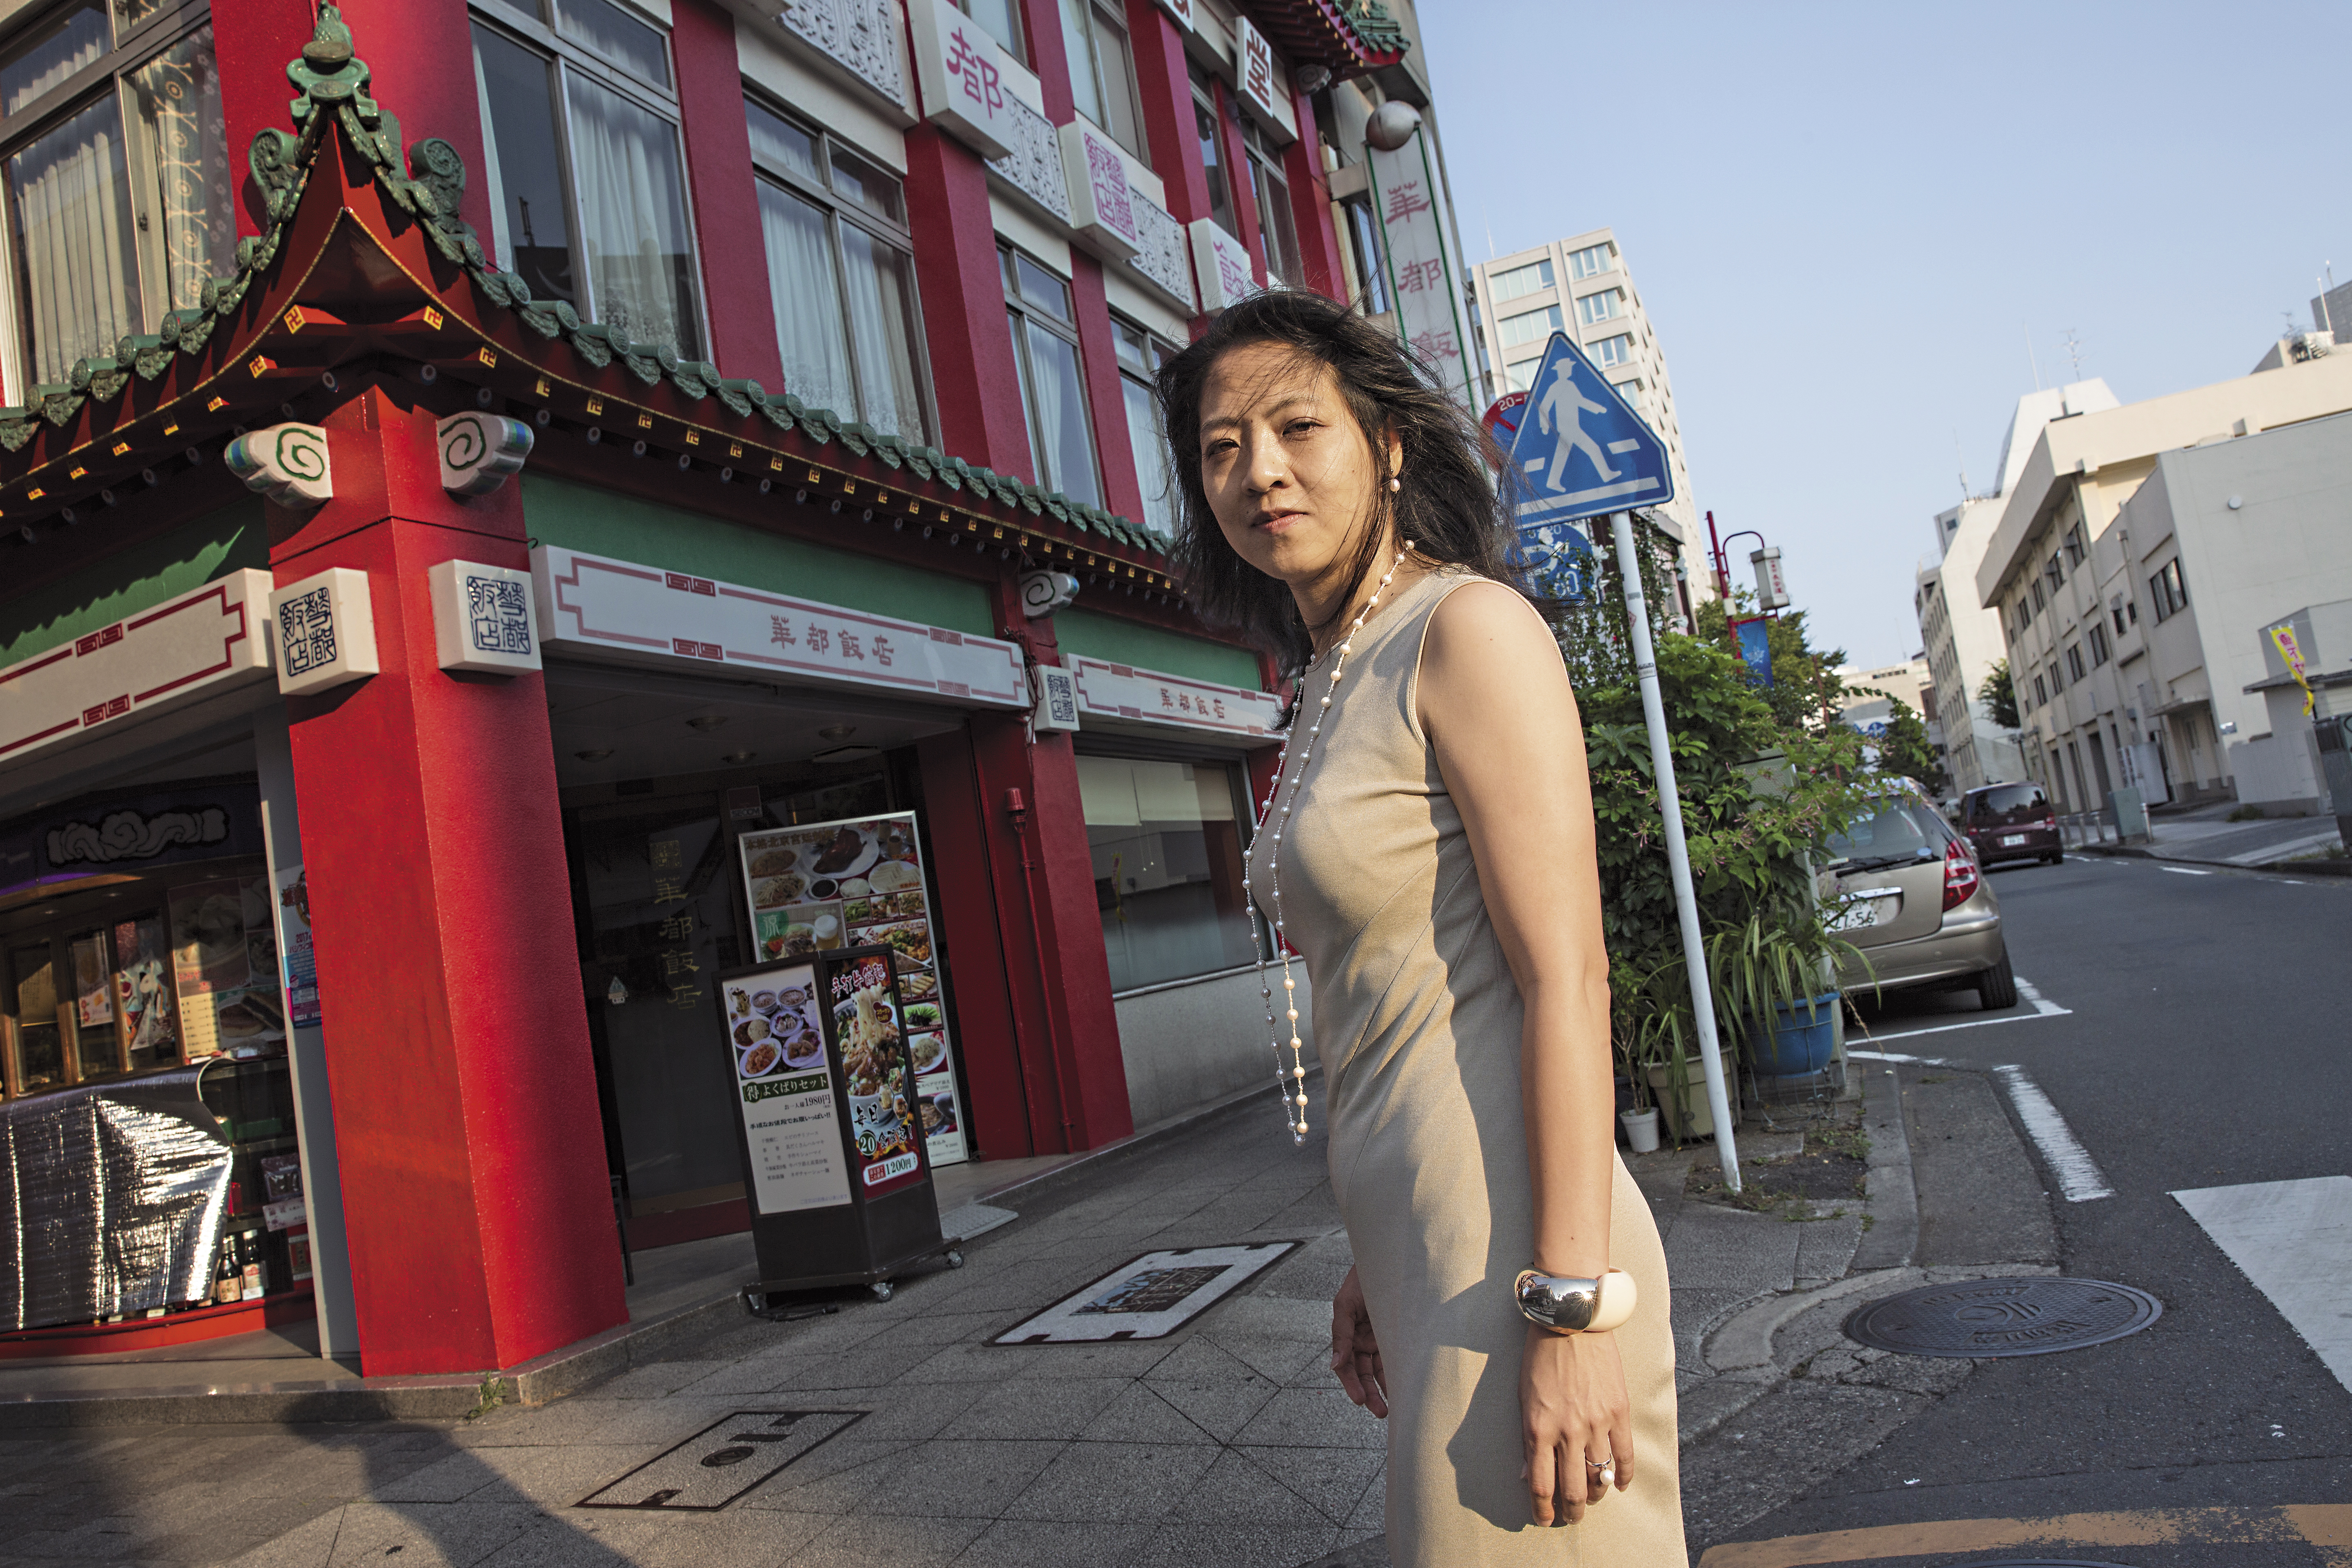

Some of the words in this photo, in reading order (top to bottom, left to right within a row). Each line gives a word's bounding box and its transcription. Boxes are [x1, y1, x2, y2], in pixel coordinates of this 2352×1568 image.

[1246, 29, 1271, 109] 堂
[771, 615, 894, 667] 華都飯店
[1160, 687, 1225, 719] 華都飯店
[654, 875, 702, 1009] 華都飯店
[854, 1102, 878, 1127] 毎日
